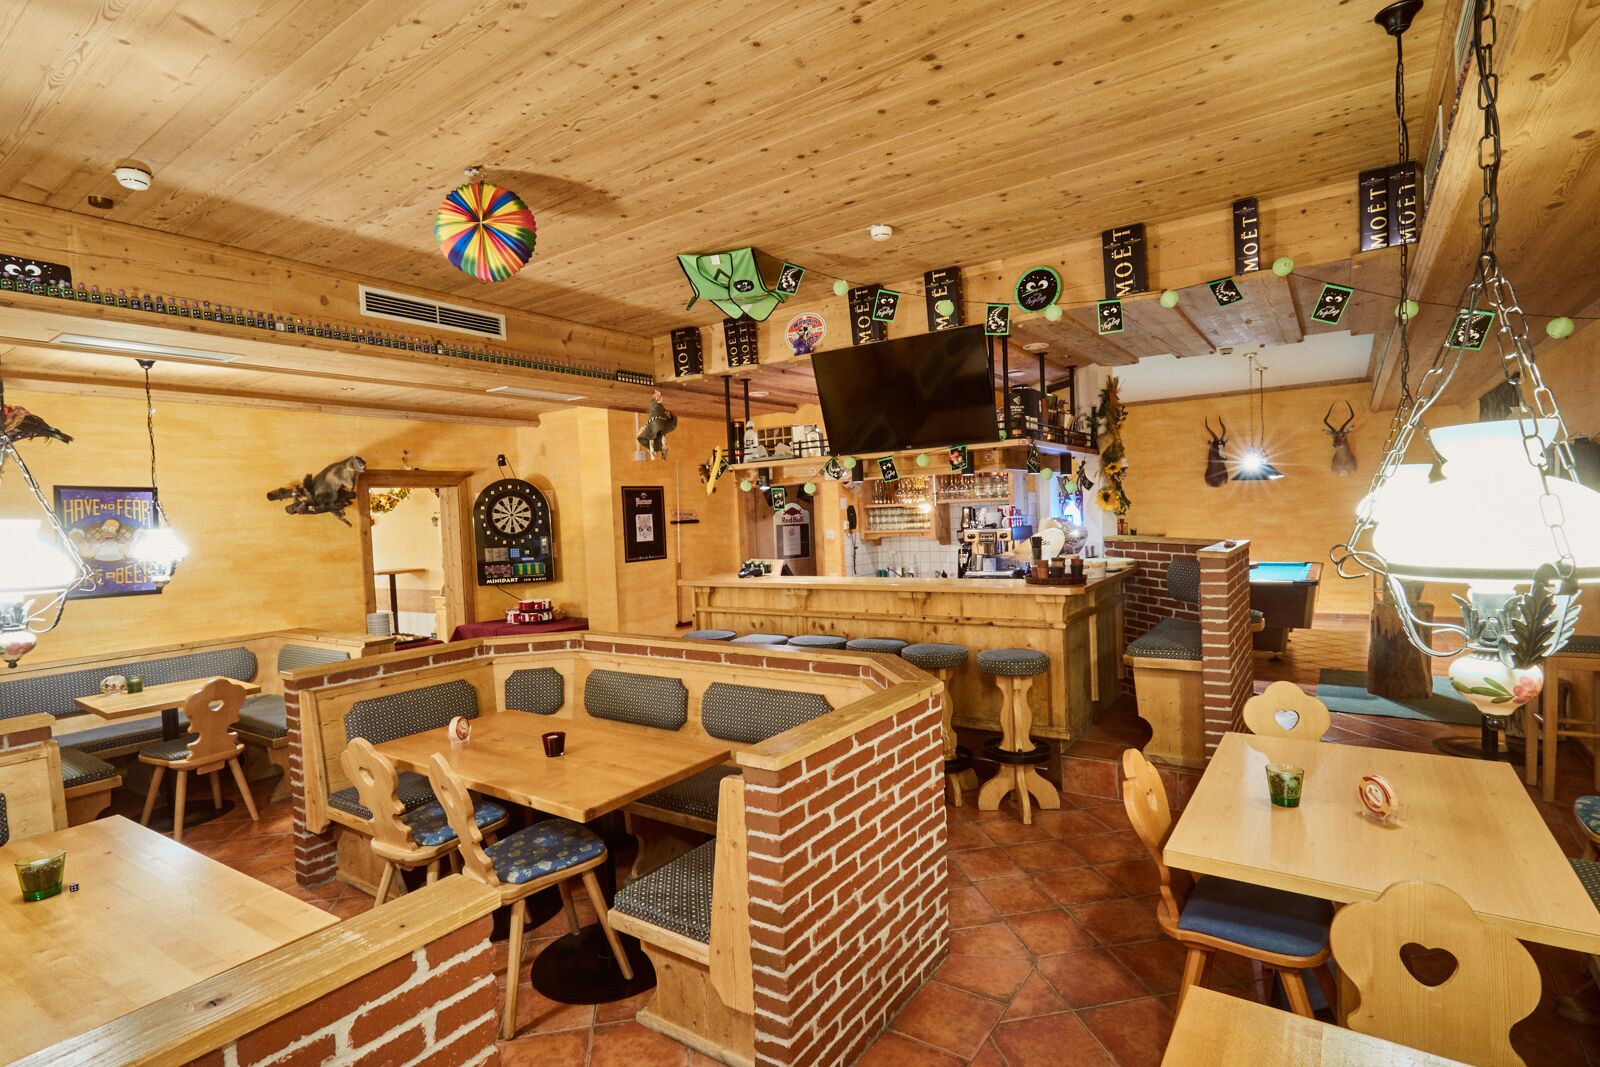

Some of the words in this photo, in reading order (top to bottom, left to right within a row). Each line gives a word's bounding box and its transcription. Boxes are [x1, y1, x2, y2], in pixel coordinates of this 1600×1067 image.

[1240, 216, 1259, 272] MOËT
[1367, 188, 1388, 249] MOËT
[1111, 228, 1134, 298] MOËT
[854, 288, 872, 345] MOËT
[63, 498, 101, 528] HAVE
[116, 499, 152, 528] FEAR
[486, 577, 519, 585] MINIDART
